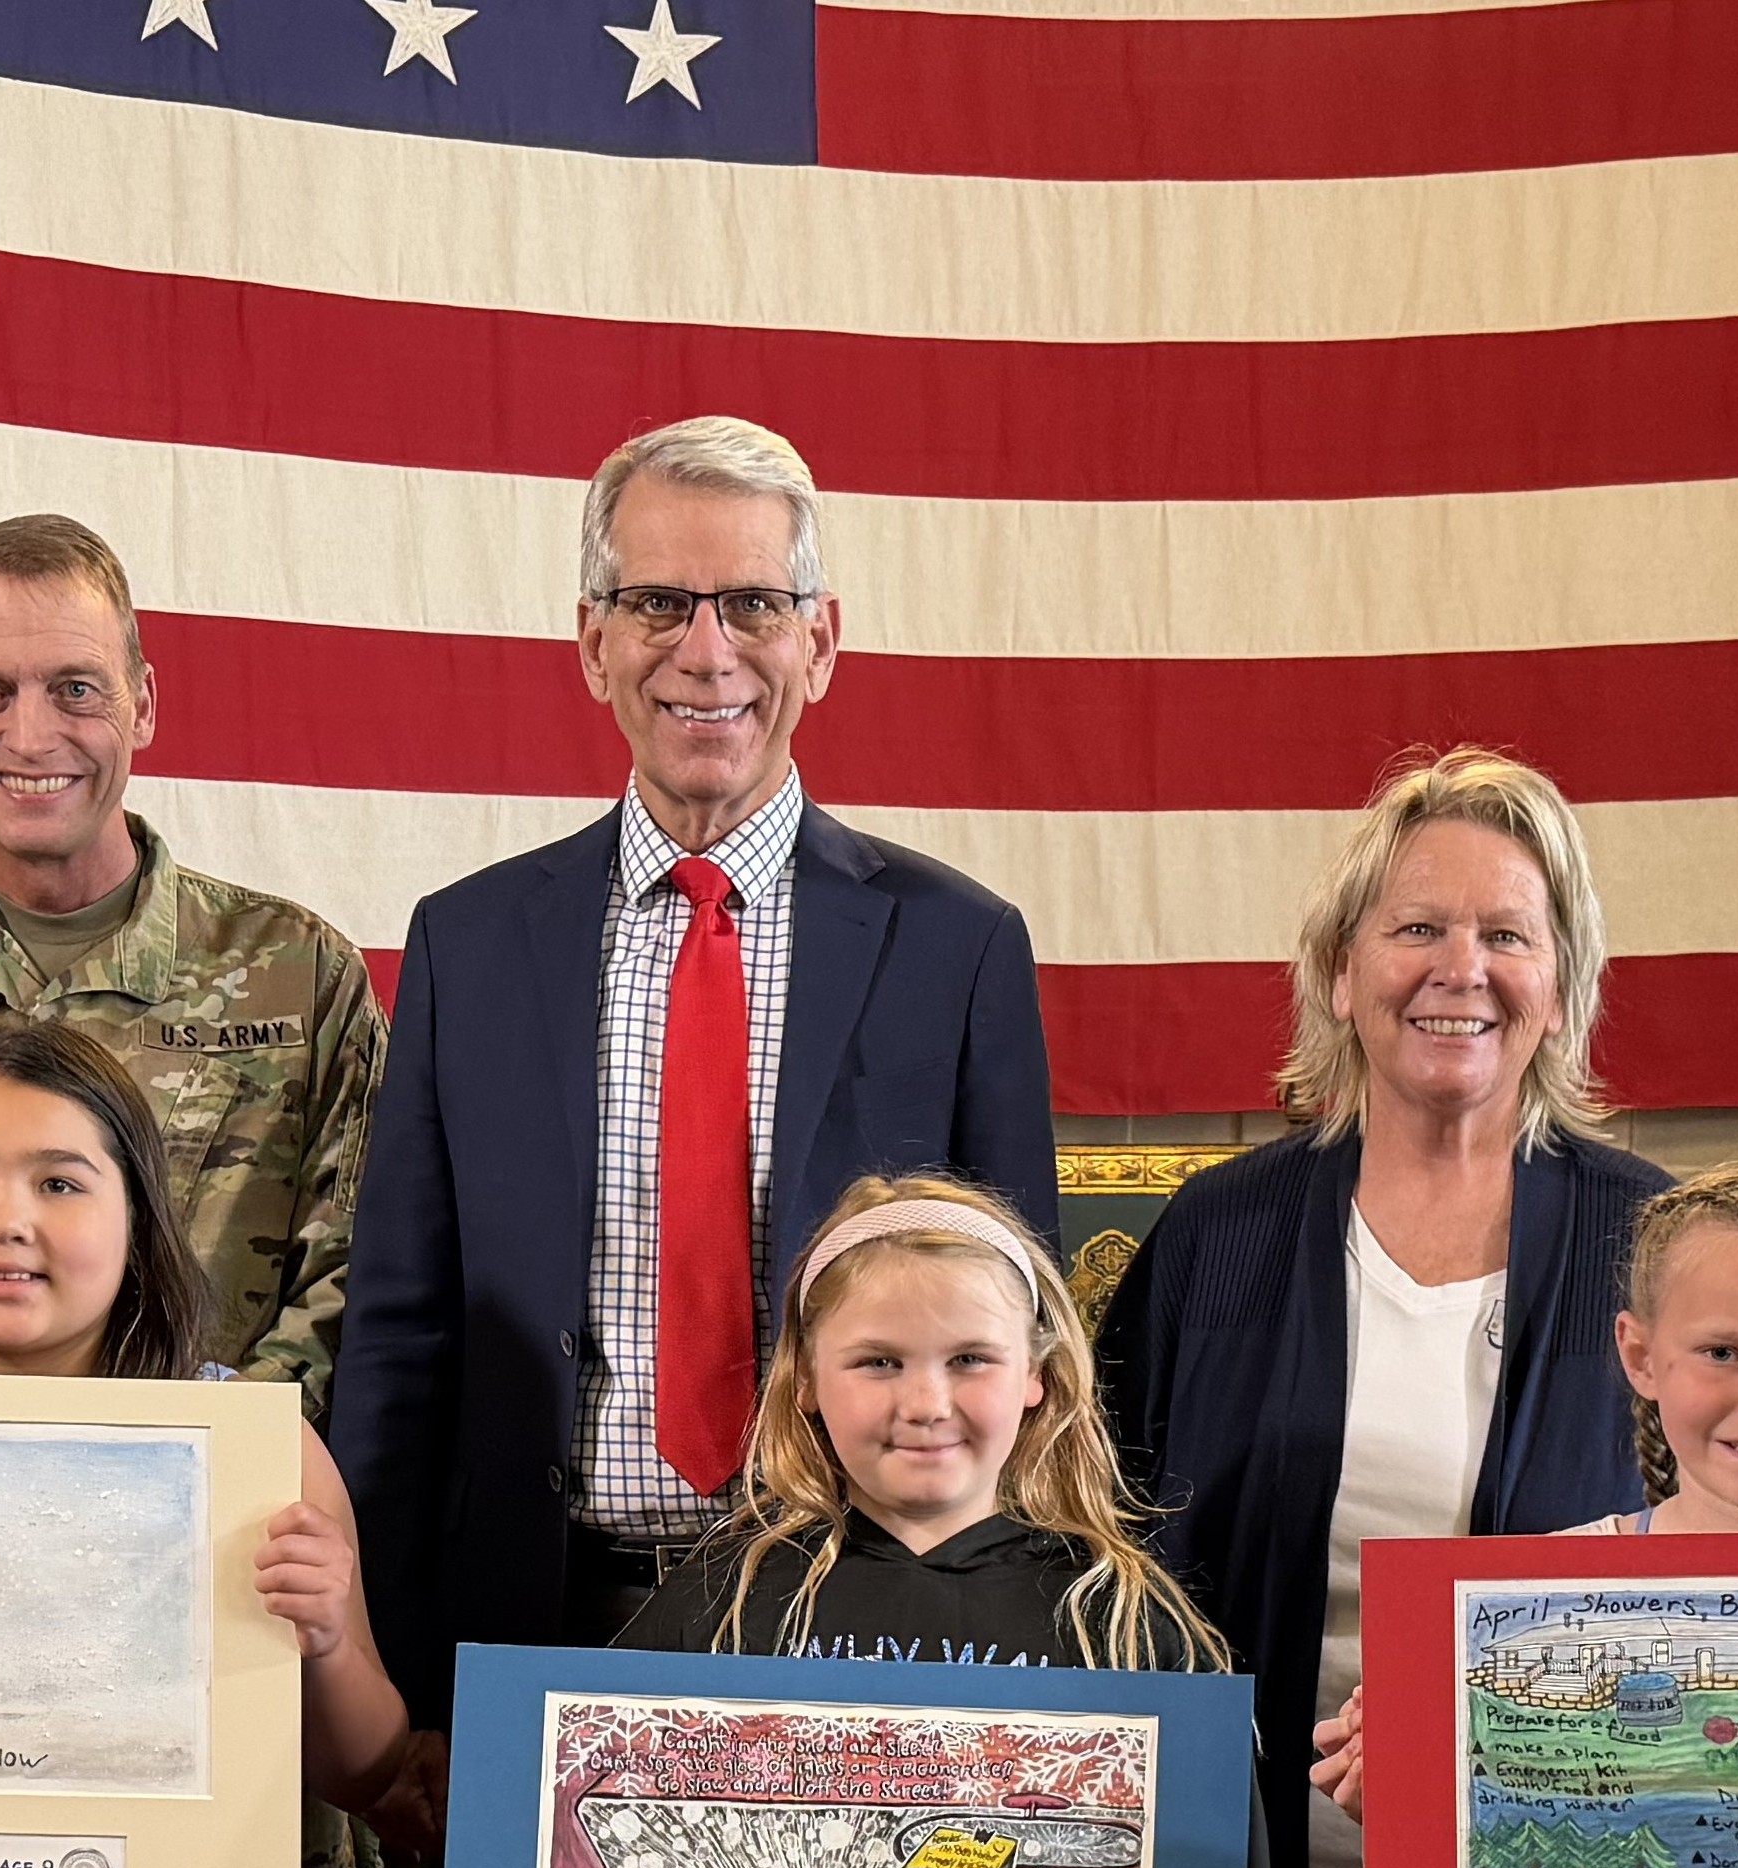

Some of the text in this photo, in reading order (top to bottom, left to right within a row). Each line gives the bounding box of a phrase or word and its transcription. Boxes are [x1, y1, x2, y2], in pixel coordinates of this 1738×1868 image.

[162, 1020, 286, 1048] U.S. ARMY
[1473, 1597, 1549, 1639] April
[1572, 1594, 1696, 1617] Showers
[1487, 1705, 1554, 1730] Prepare
[1554, 1712, 1587, 1729] for
[849, 1735, 881, 1755] and
[1573, 1746, 1618, 1765] plan
[1496, 1760, 1591, 1785] Emergency
[731, 1776, 764, 1794] and
[837, 1779, 873, 1798] the
[1598, 1780, 1634, 1796] and
[1478, 1791, 1635, 1817] drinking water
